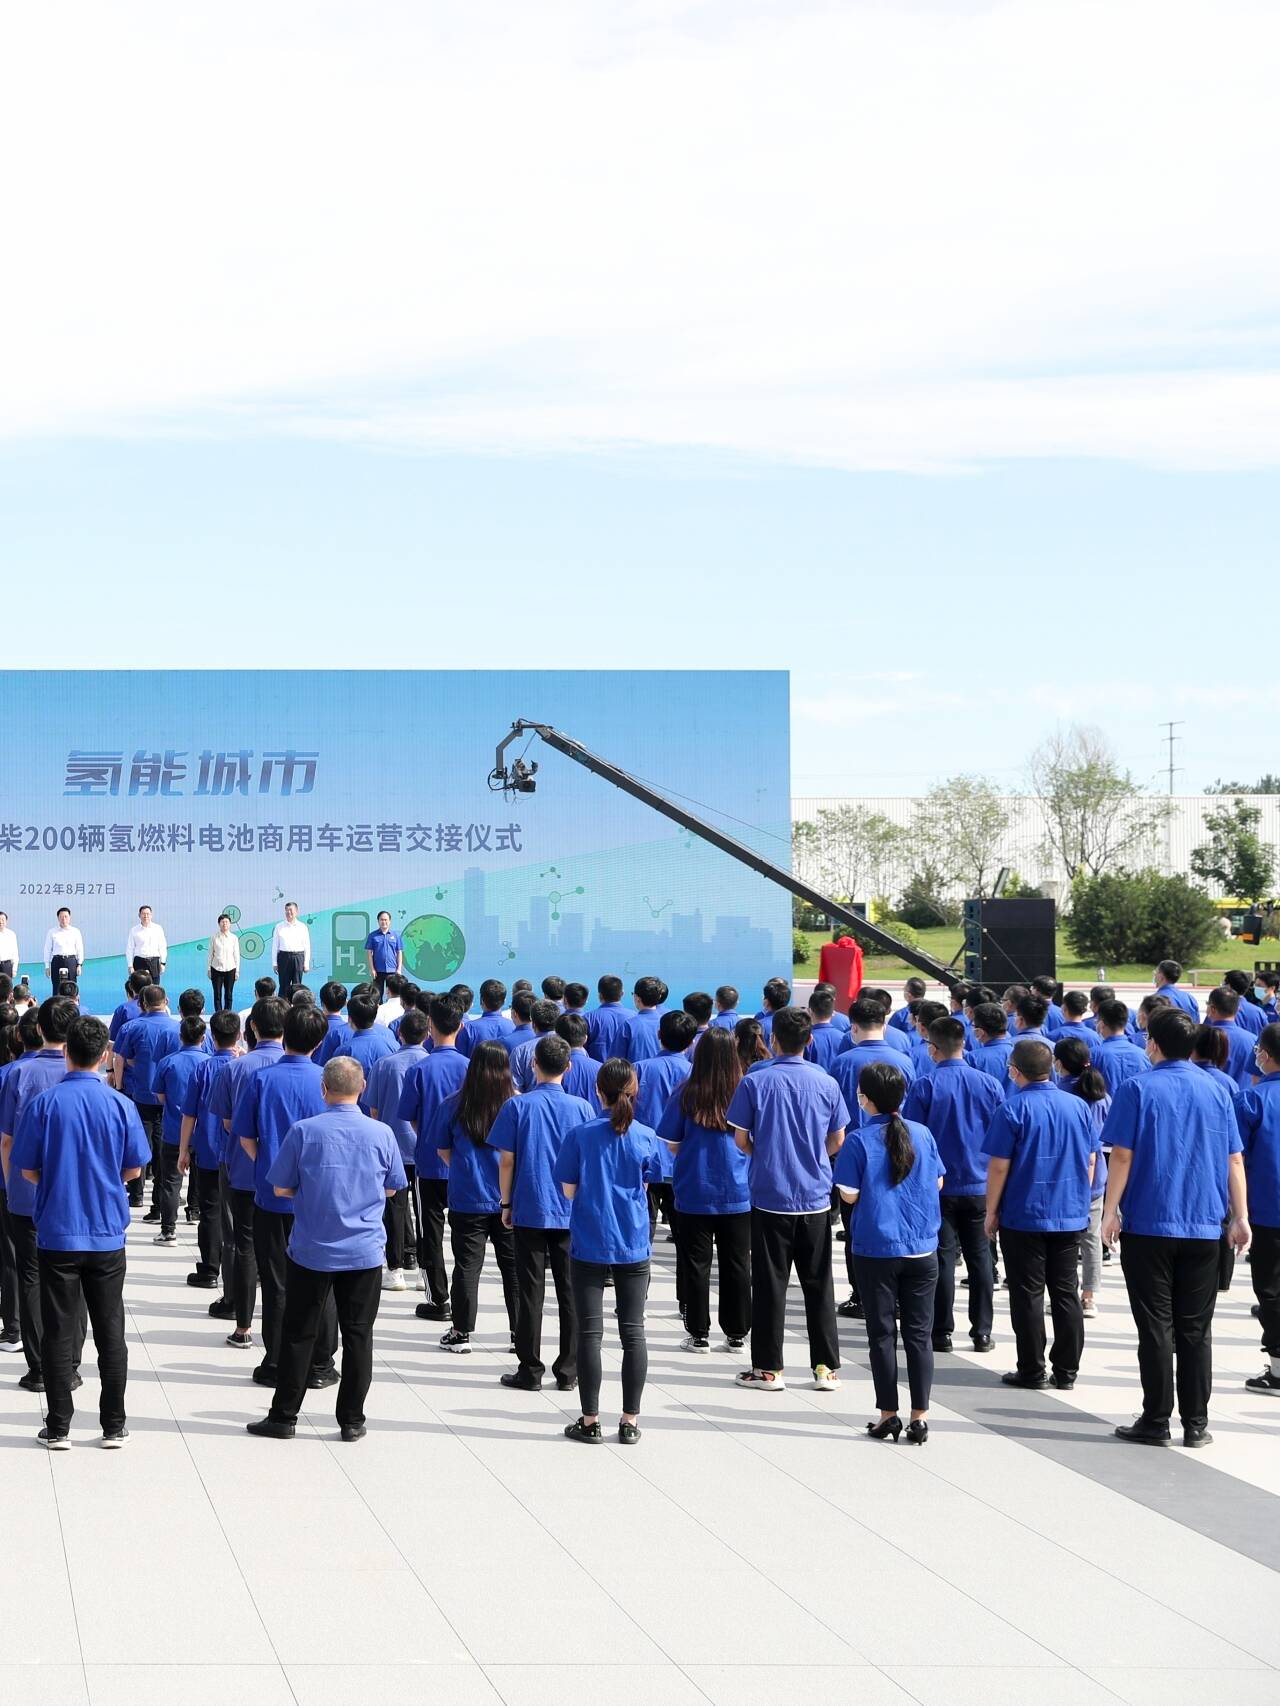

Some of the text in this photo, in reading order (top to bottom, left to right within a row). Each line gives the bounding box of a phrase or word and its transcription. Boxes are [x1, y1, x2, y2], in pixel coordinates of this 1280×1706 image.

[62, 749, 321, 797] 氢能城市
[19, 882, 116, 896] 2022年8月27日
